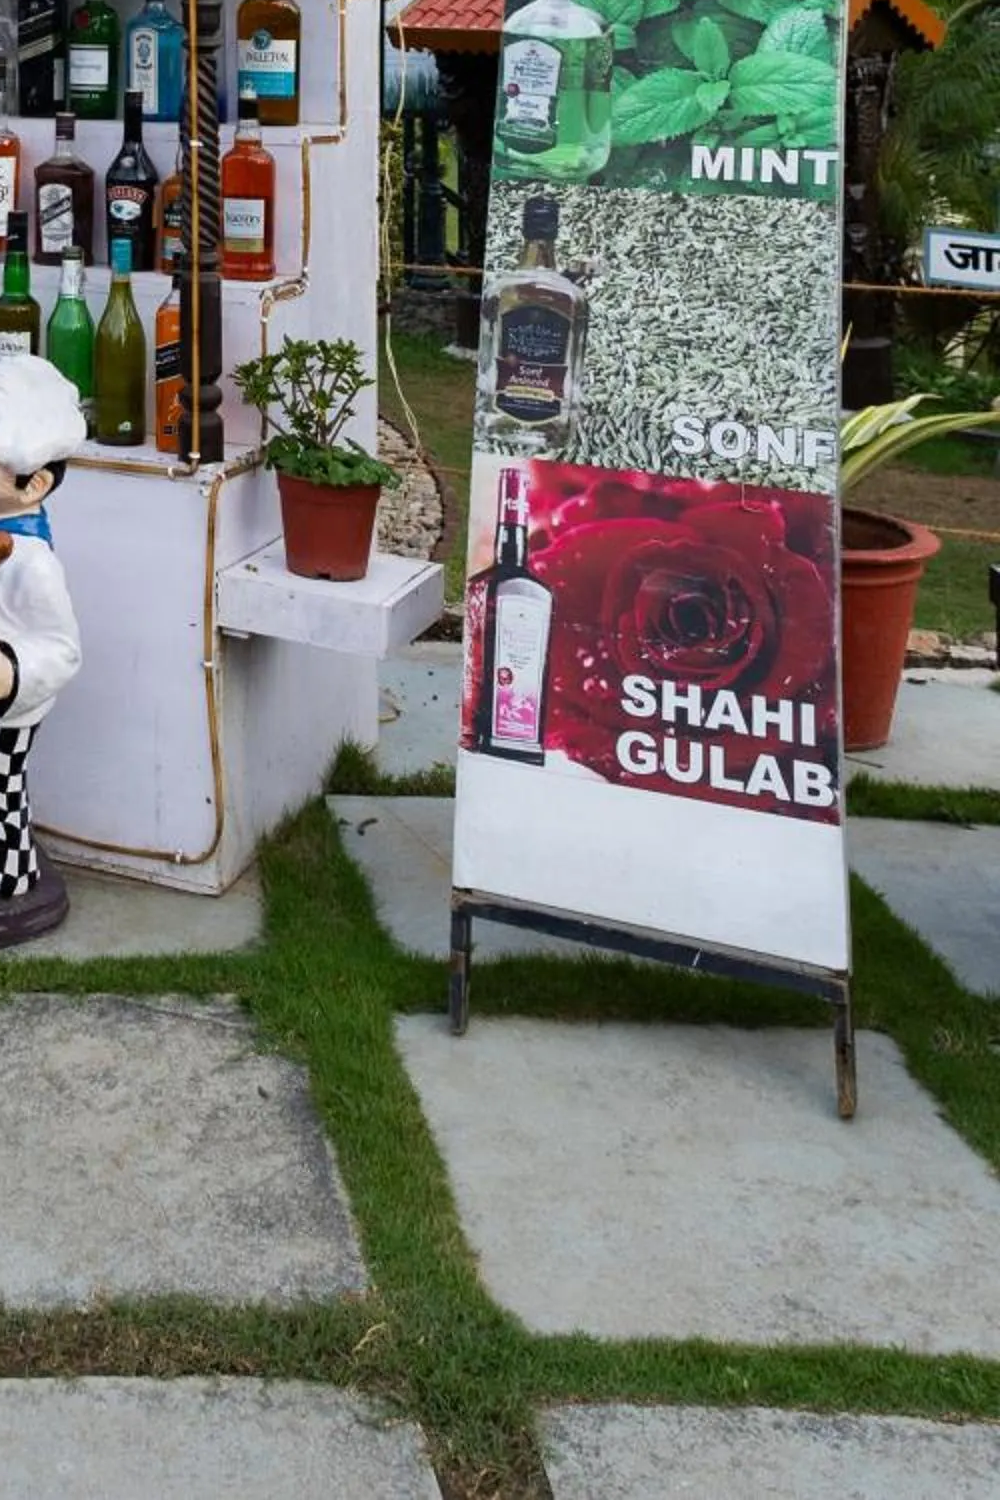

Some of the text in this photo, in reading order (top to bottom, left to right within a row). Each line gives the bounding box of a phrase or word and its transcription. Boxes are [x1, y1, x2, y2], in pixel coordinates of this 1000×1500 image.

[690, 145, 838, 186] MINT
[944, 243, 1000, 273] जा
[671, 415, 835, 468] SONF
[620, 674, 816, 747] SHAHI
[615, 730, 835, 807] GULAB
